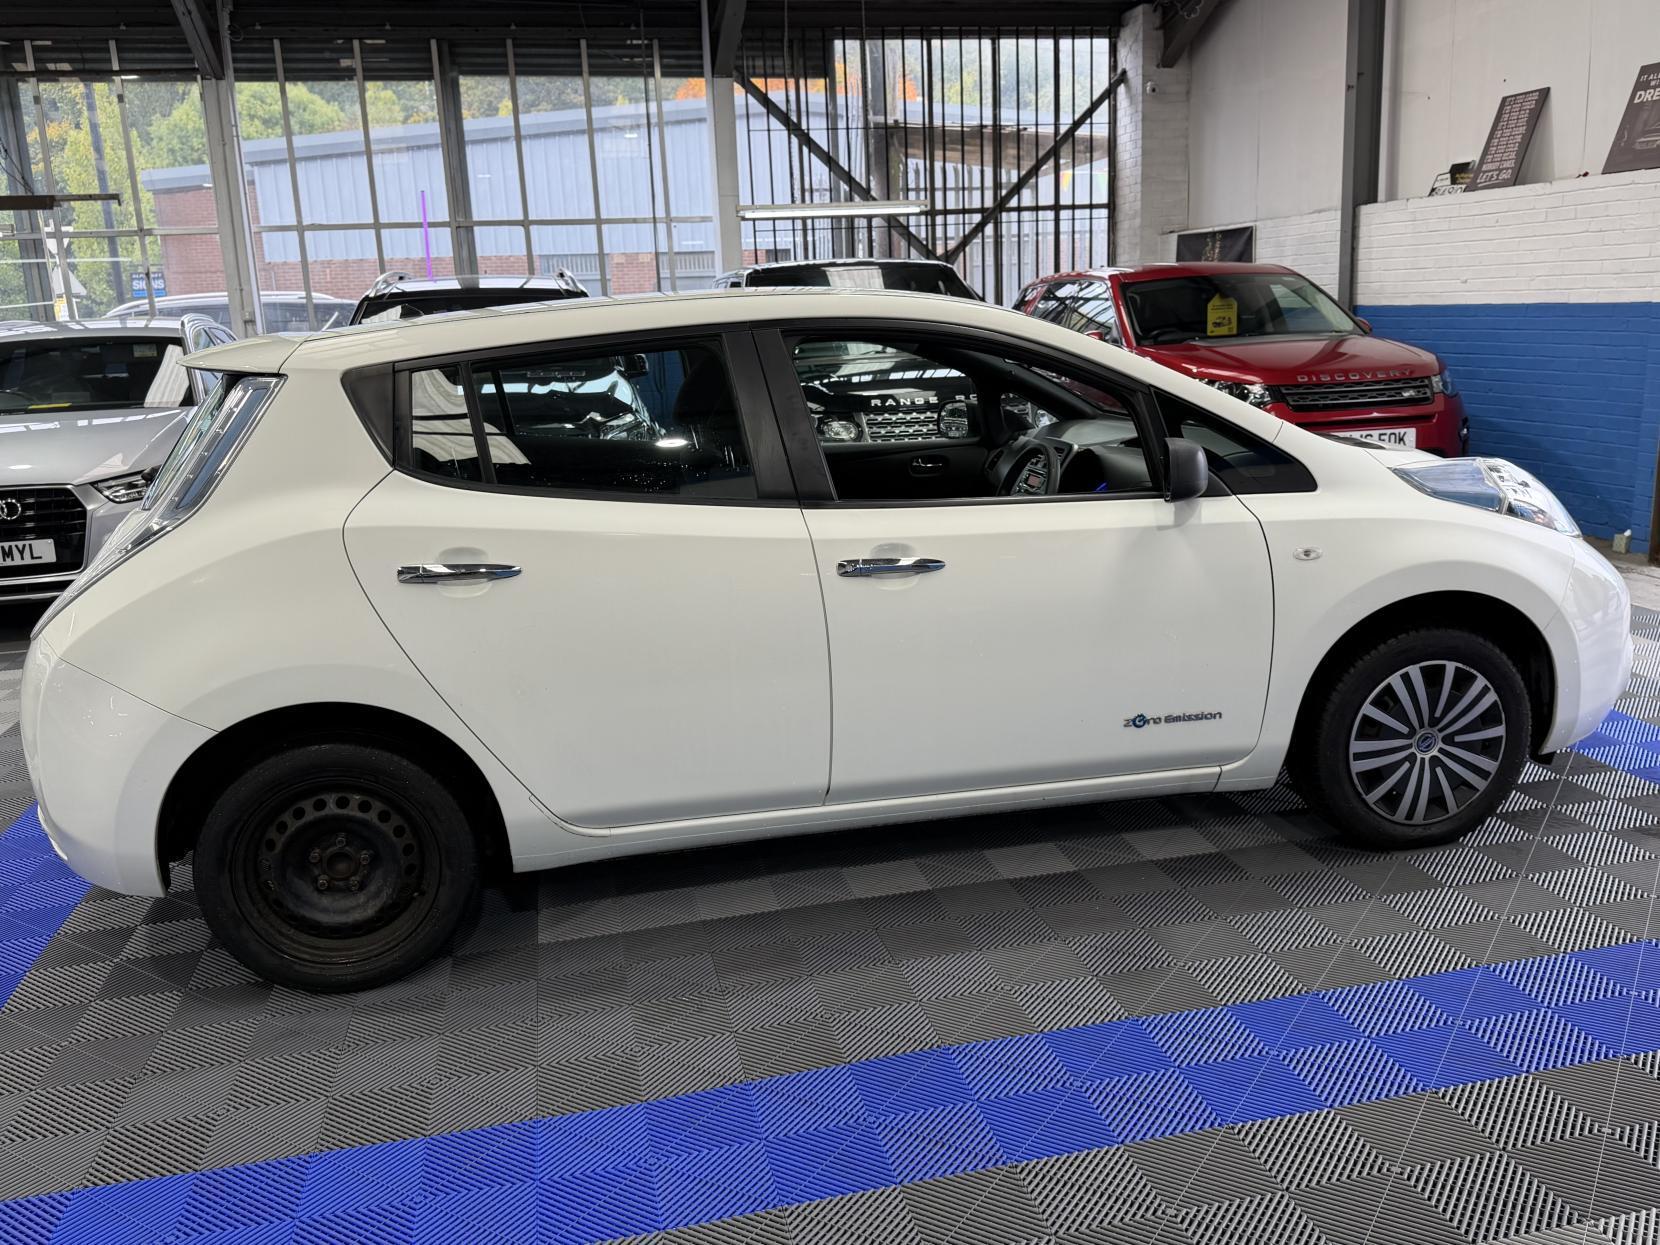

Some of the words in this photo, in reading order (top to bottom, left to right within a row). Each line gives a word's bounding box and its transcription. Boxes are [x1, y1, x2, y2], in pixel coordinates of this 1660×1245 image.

[1476, 170, 1498, 182] LET'S
[1297, 369, 1412, 382] DISCOVERY
[871, 396, 938, 406] RANGE
[1, 543, 42, 562] MYL
